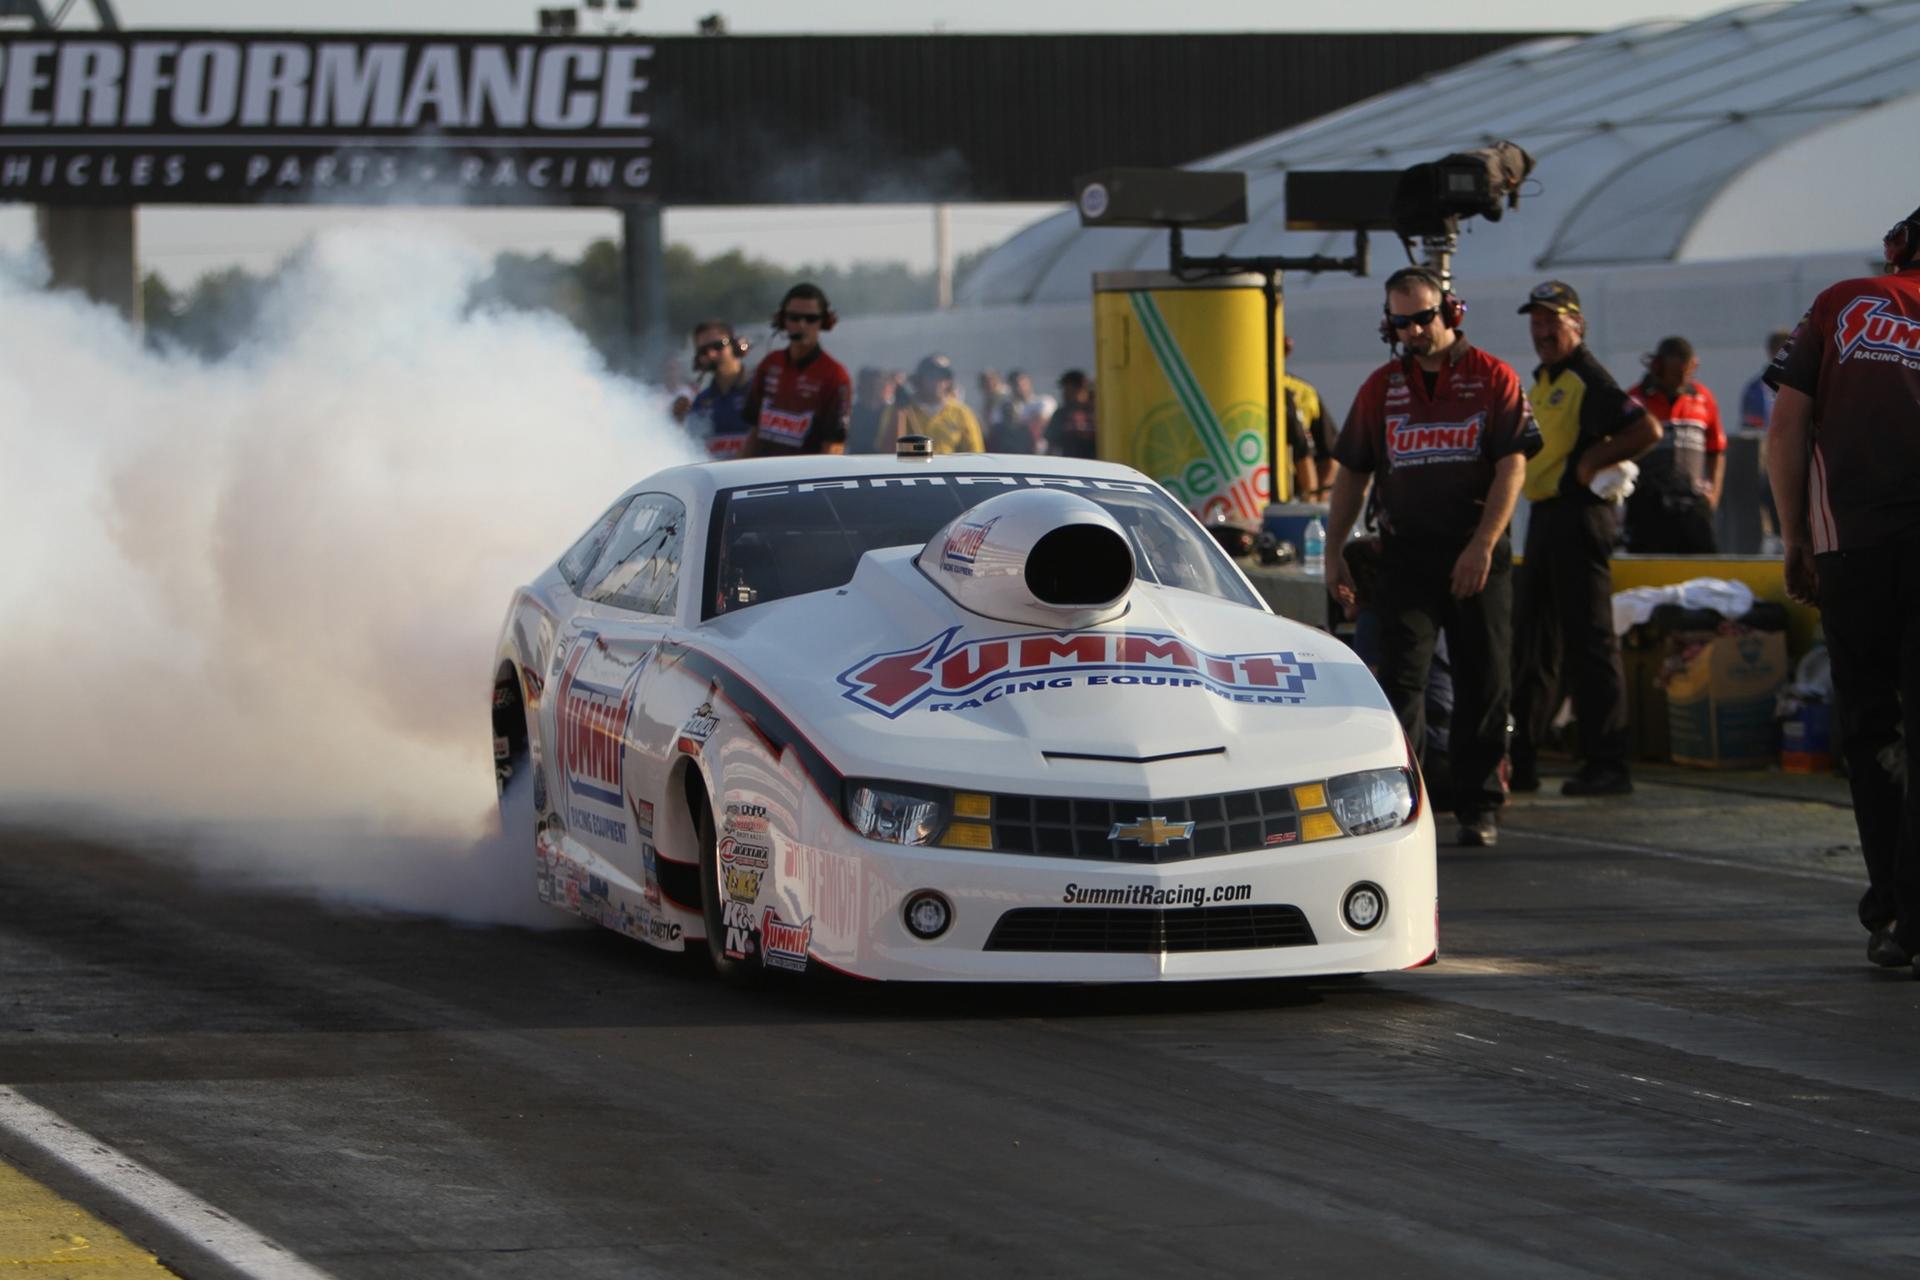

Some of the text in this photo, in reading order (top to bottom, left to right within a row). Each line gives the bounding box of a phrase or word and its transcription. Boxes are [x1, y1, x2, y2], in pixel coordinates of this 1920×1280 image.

[0, 40, 655, 130] ERFORMANCE
[246, 155, 400, 187] PARTS
[459, 156, 653, 188] RACING
[1853, 350, 1900, 363] RACING
[1386, 418, 1481, 452] SUMMIT
[856, 634, 1291, 707] SUMMIT
[929, 674, 1307, 712] RACING EQUIPMENT
[1062, 882, 1252, 906] SummitRacing.com
[761, 909, 811, 955] SUMMIT
